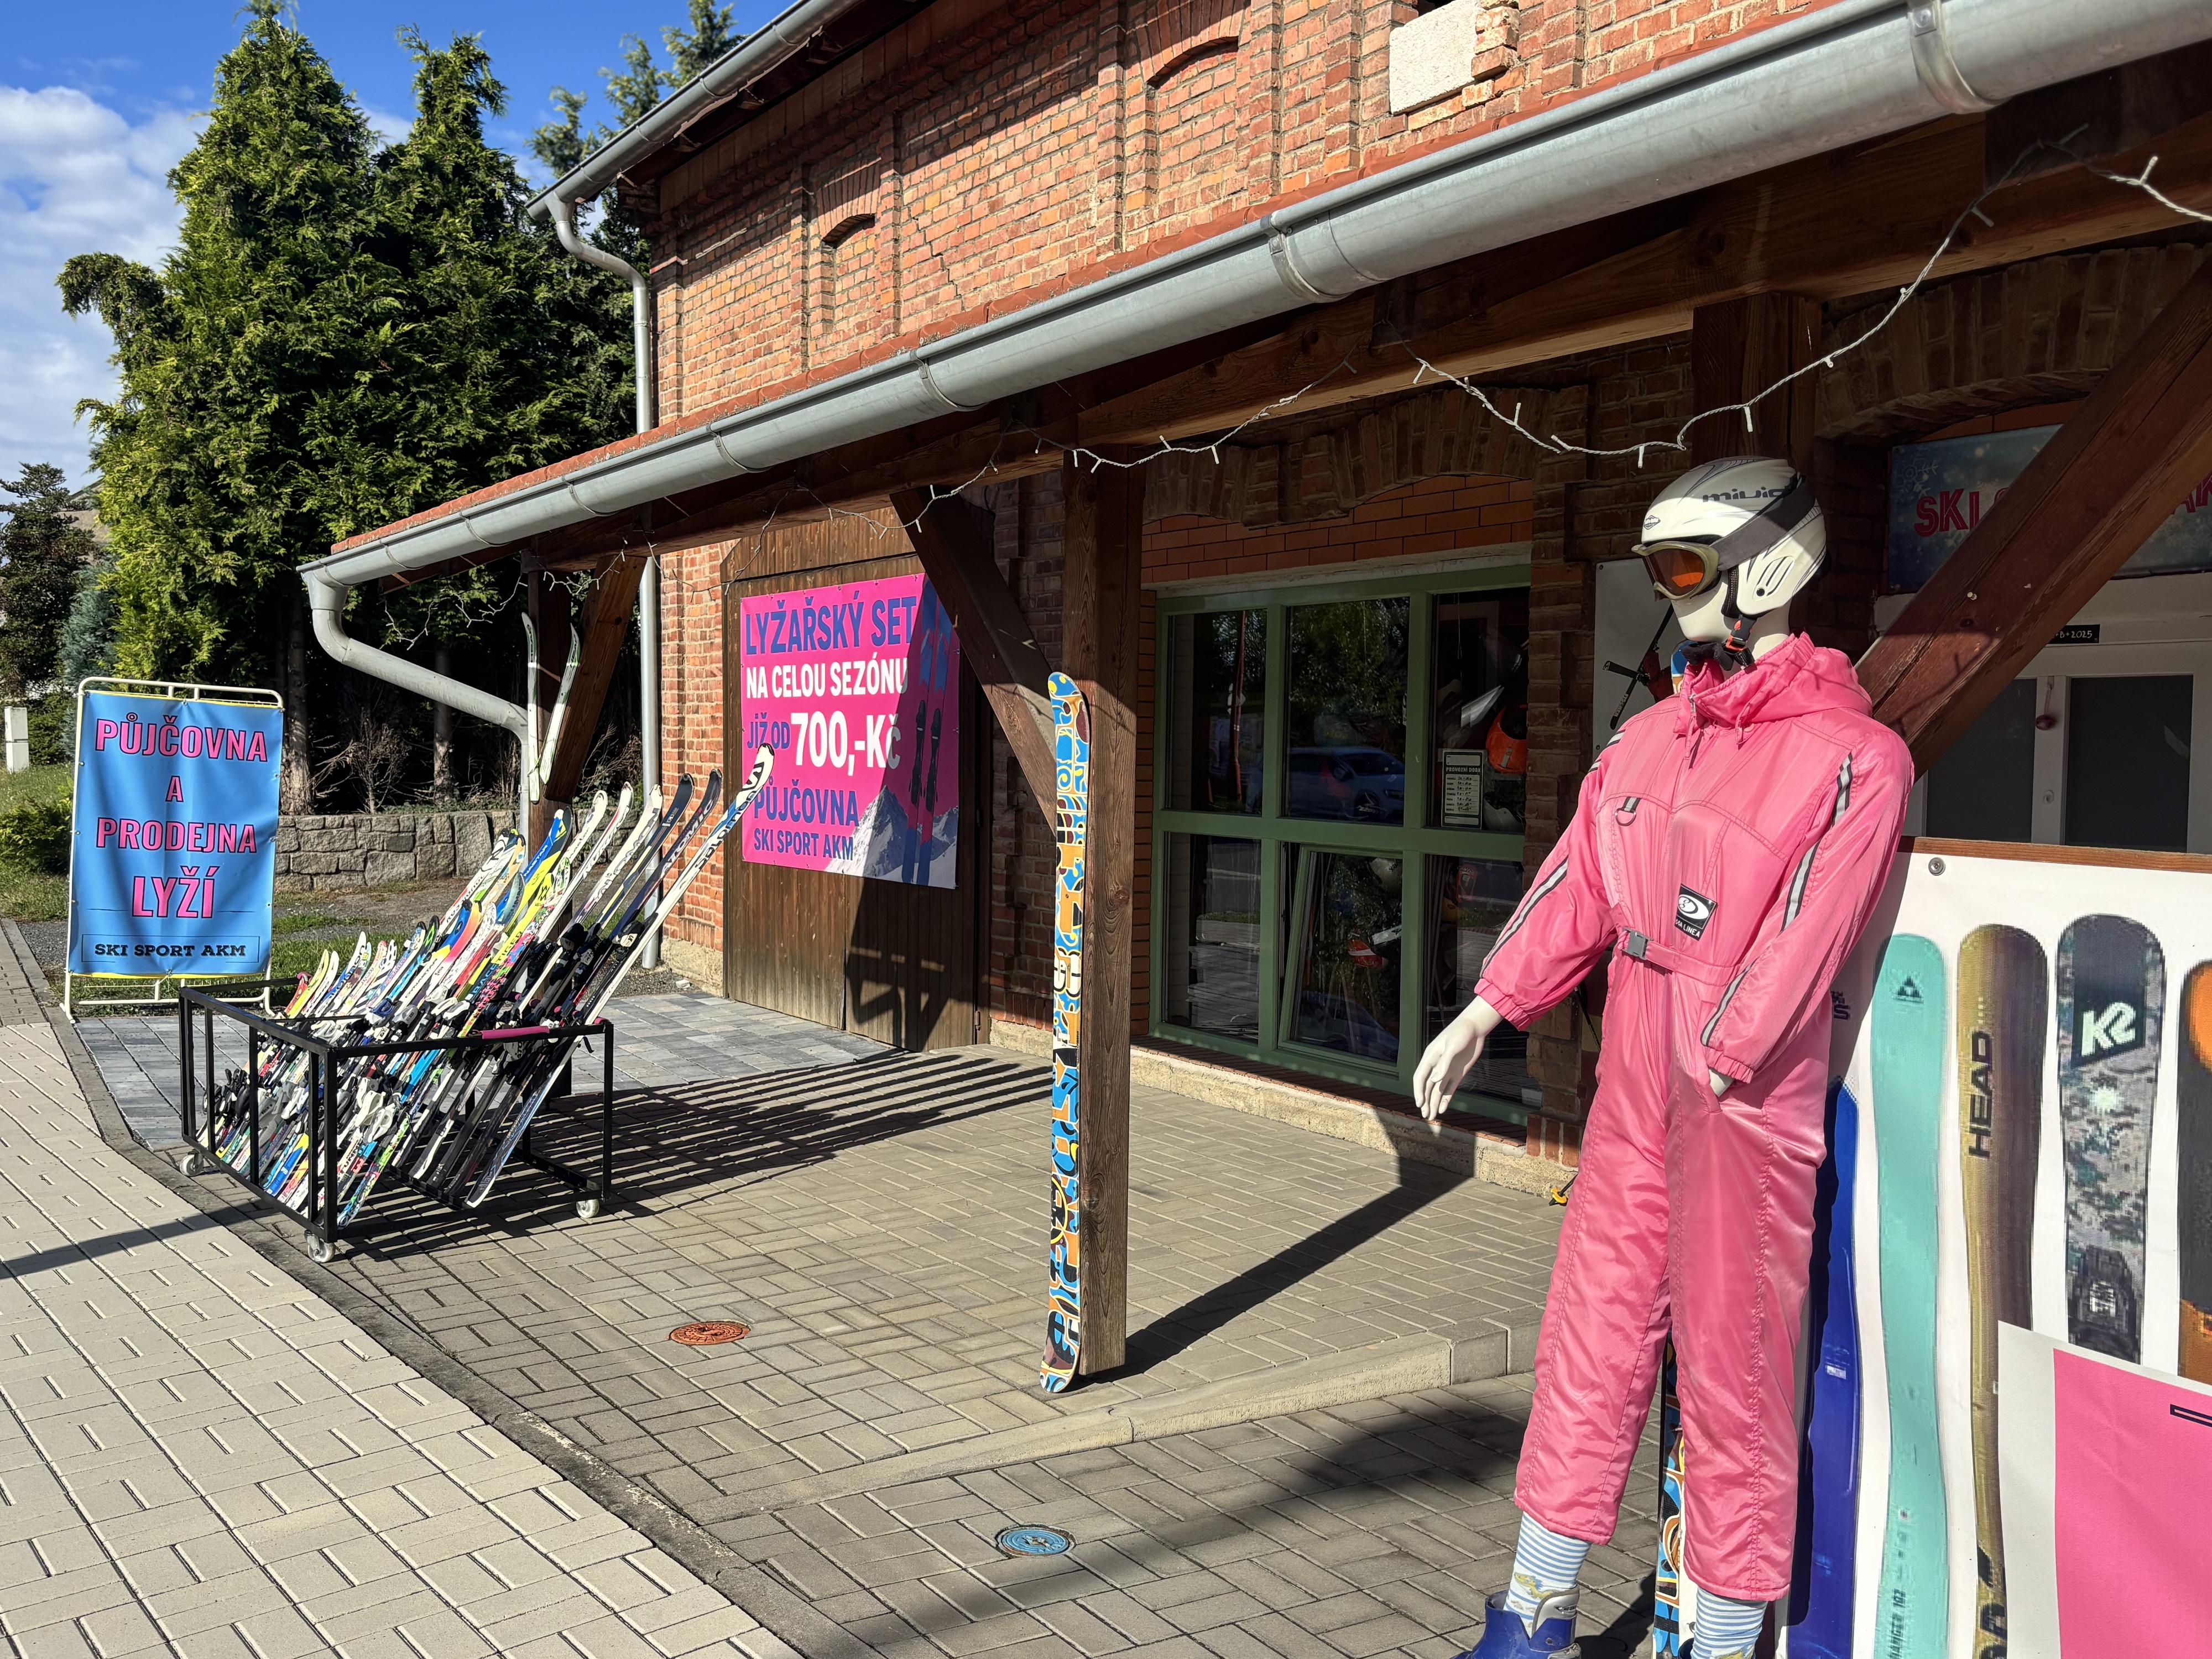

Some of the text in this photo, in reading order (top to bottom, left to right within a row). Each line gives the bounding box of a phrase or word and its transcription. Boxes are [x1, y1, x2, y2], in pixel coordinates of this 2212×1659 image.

[1914, 488, 1980, 538] SKI
[745, 590, 917, 655] LYŽAŘSKÝ SET
[746, 652, 908, 699] NA CELOU SEZÓNU
[95, 712, 268, 763] PŮJČOVNA
[773, 721, 791, 750] OD
[166, 775, 184, 802] A
[754, 777, 859, 827] PŮJČOVNA
[96, 817, 258, 853] PRODEJNA
[662, 800, 713, 877] ATOMIC
[754, 828, 854, 861] SKI SPORT AKM
[132, 865, 221, 919] LYŽÍ
[94, 943, 247, 957] SKI SPORT AKM
[1683, 924, 1701, 938] LINEA
[405, 958, 437, 998] DYNASTAR
[2081, 1000, 2136, 1058] K2
[1968, 1030, 1994, 1160] HEAD
